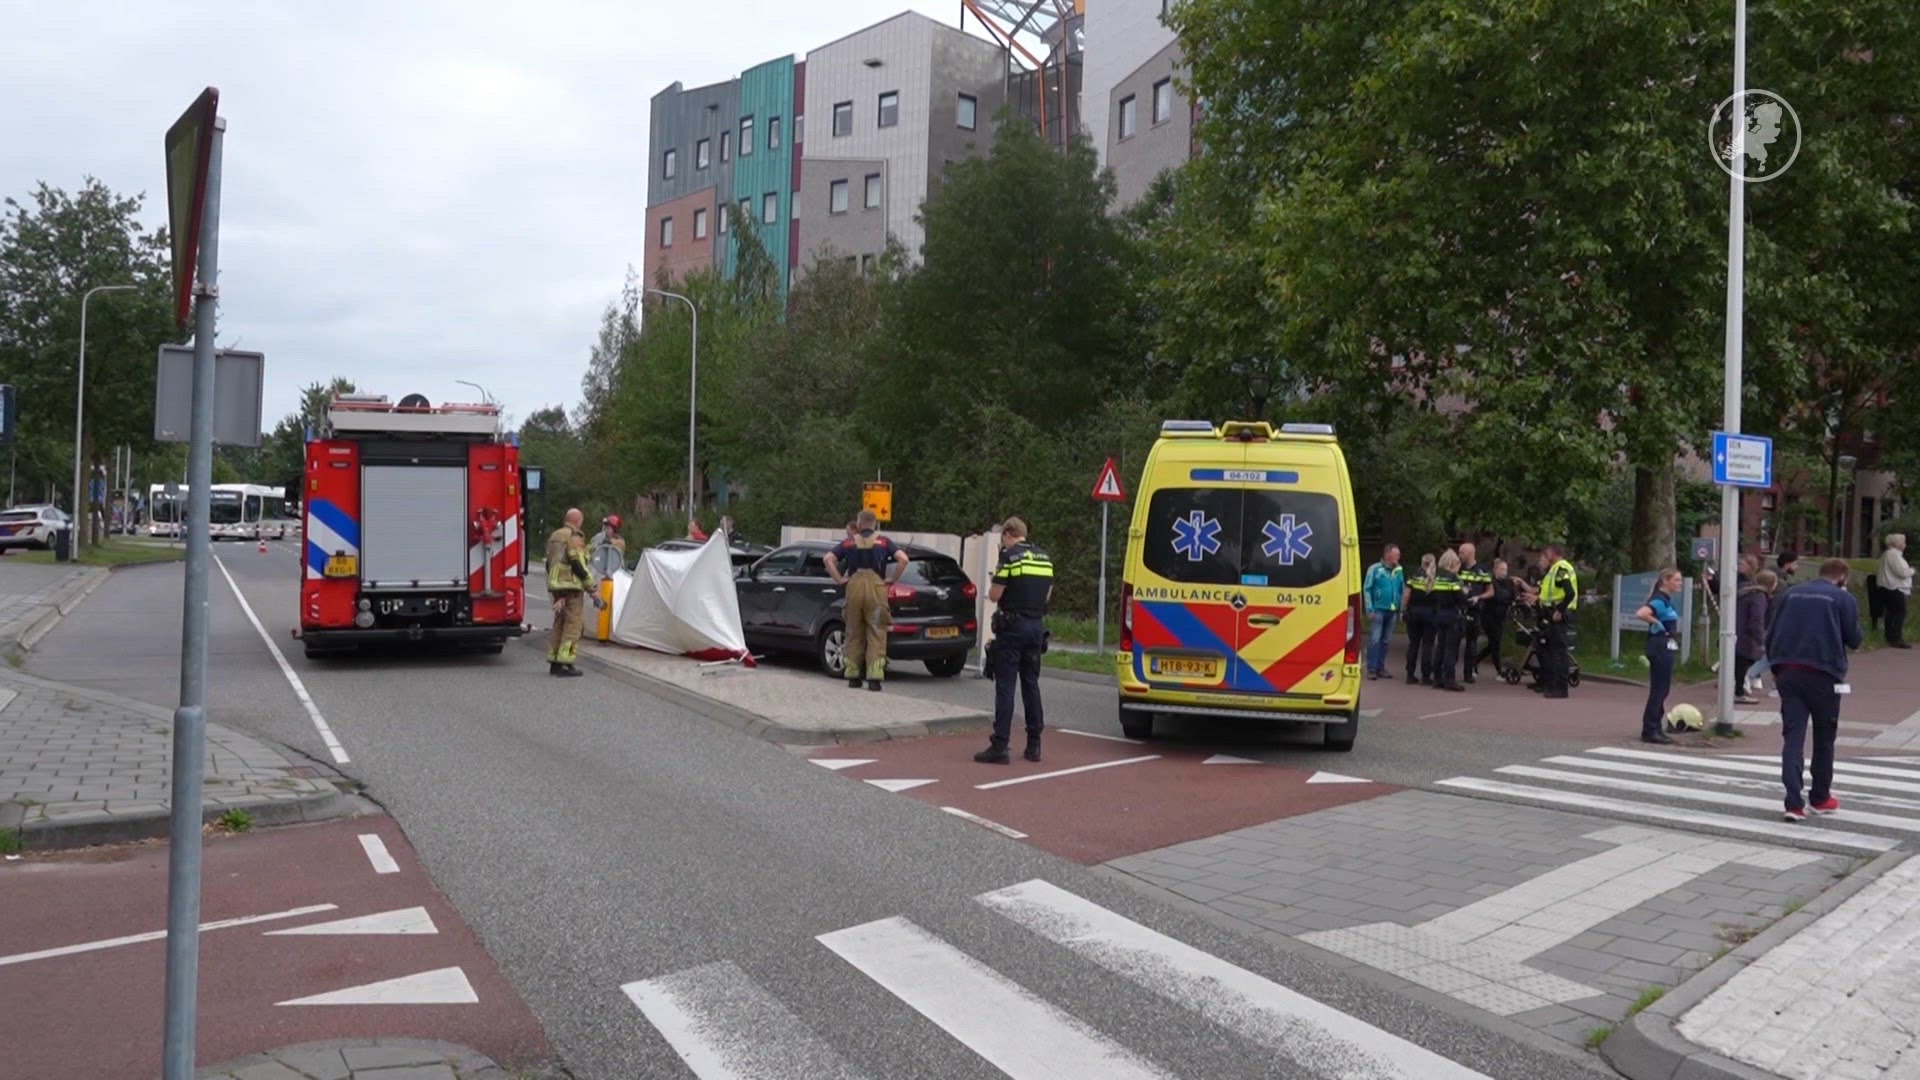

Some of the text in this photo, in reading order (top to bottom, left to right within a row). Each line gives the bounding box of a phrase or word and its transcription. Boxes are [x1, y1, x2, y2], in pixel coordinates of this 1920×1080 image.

[1229, 471, 1261, 480] 04-102
[1134, 586, 1232, 601] AMBULANCE
[1276, 592, 1322, 605] 04-102
